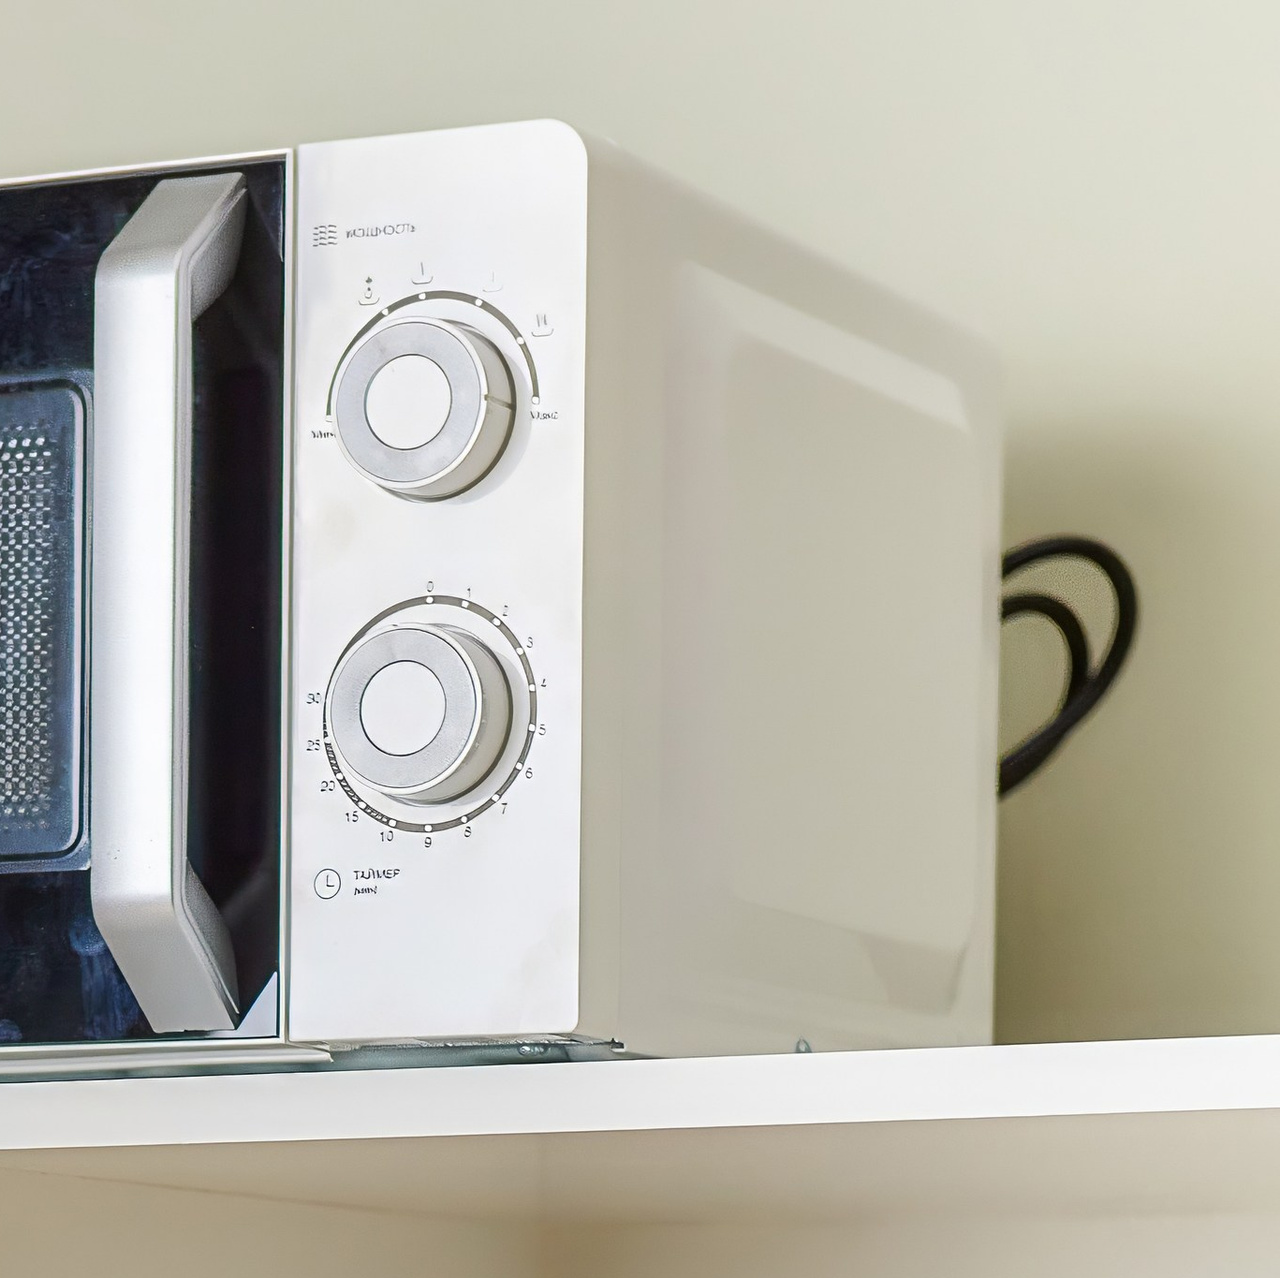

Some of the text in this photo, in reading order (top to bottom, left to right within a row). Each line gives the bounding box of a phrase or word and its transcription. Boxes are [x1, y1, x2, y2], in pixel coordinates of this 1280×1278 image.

[426, 580, 435, 593] 0
[465, 587, 472, 599] 1
[538, 723, 547, 737] 5
[524, 767, 534, 780] 6
[501, 803, 509, 816] 7
[344, 810, 360, 823] 15
[379, 830, 394, 843] 10
[463, 826, 473, 839] 8
[423, 836, 433, 849] 9
